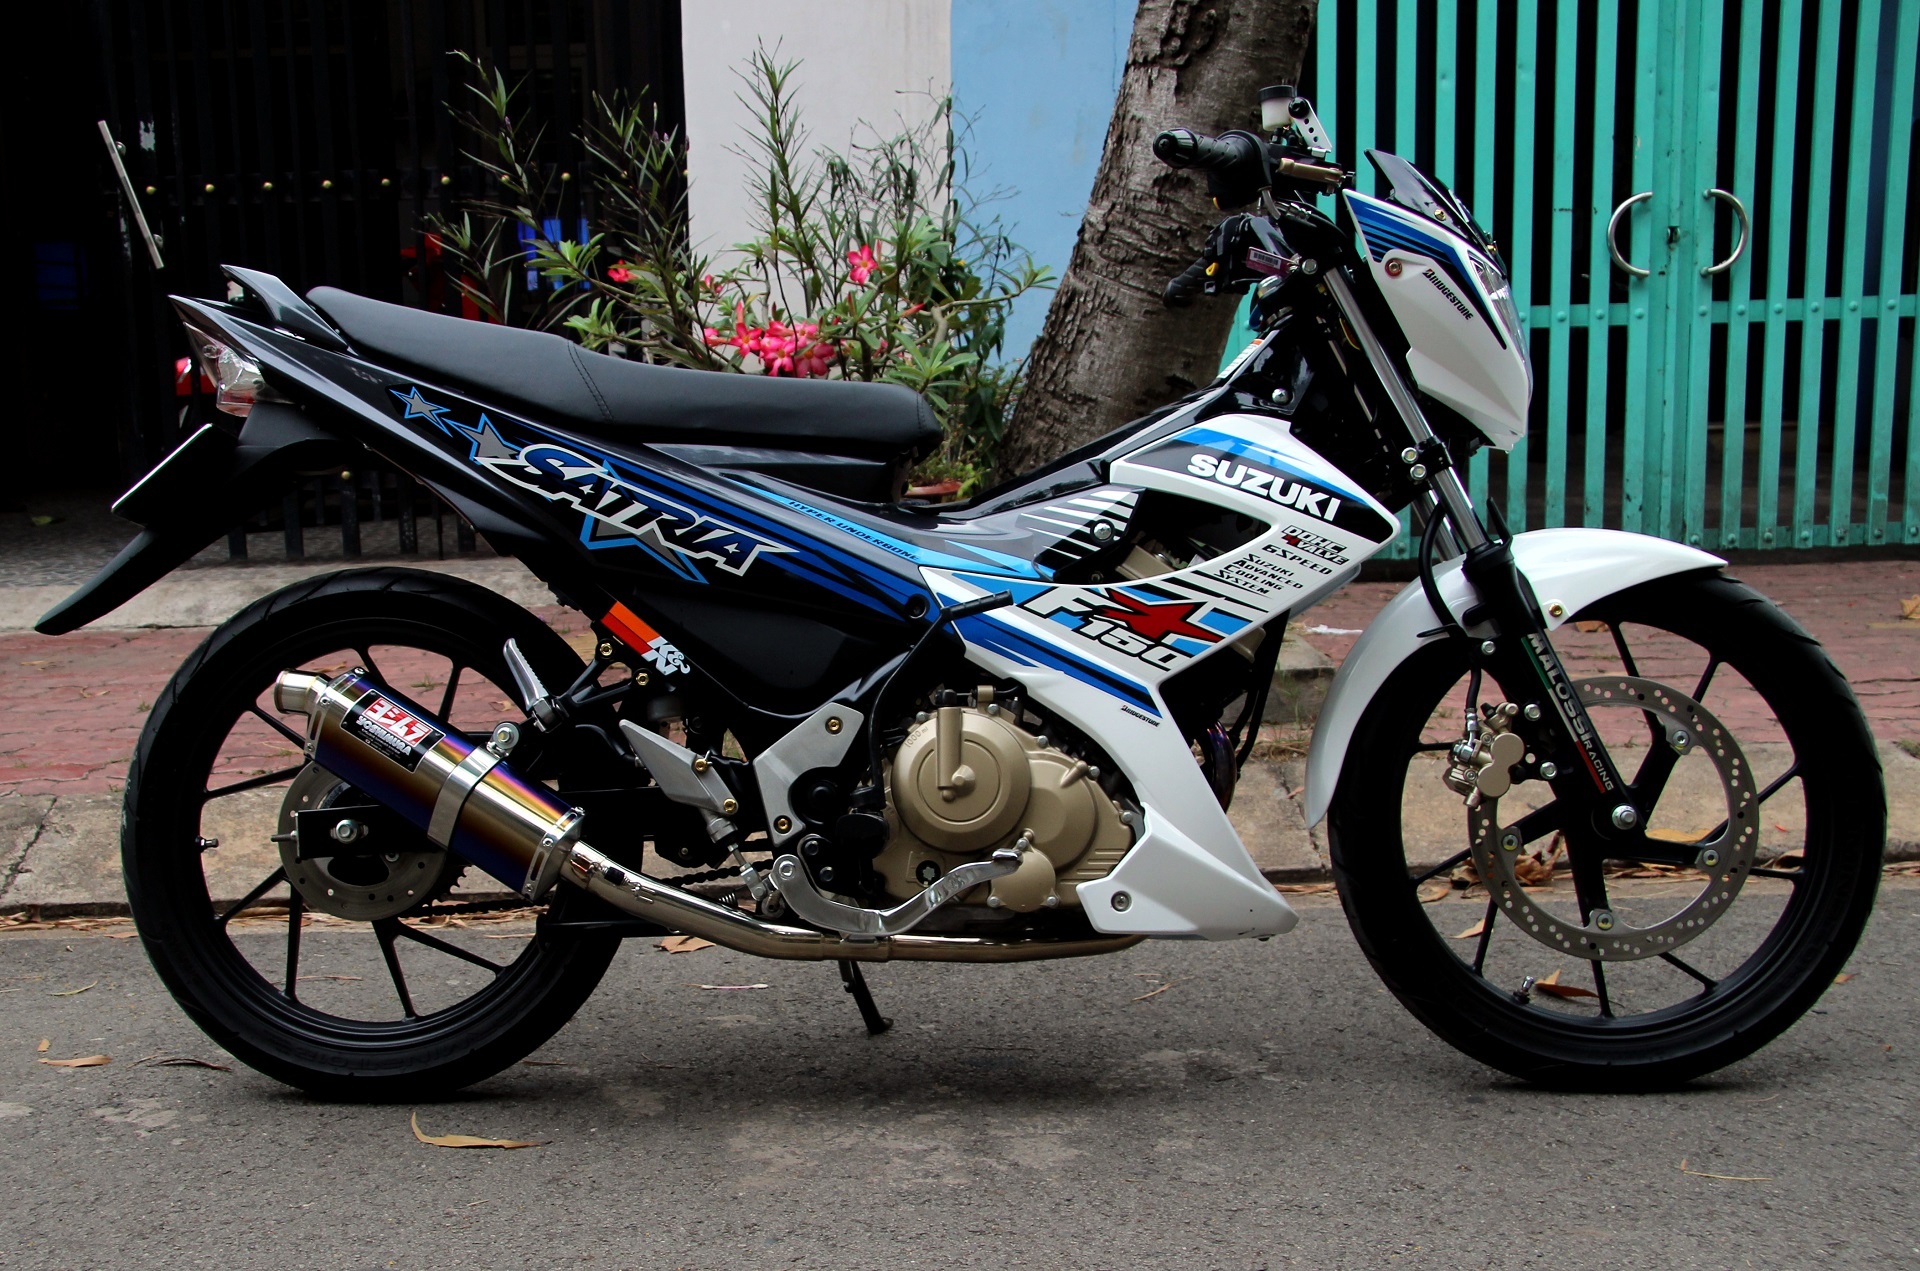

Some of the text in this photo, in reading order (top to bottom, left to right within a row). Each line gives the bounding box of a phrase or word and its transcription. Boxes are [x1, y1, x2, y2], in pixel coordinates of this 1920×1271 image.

[1422, 268, 1474, 320] BRIDGESTONE
[1187, 453, 1342, 522] SUZUKI
[474, 443, 799, 576] SATRIA
[789, 501, 920, 561] HYPER UNDERBONE
[1282, 525, 1347, 553] DOHC
[1213, 568, 1270, 596] SYSTEM
[1223, 563, 1285, 591] COOLING
[1234, 559, 1304, 589] ADVANCED
[1243, 553, 1295, 577] SUZUKI
[1527, 633, 1615, 792] MALOSSI RACING
[355, 715, 412, 756] YOSHIMURA
